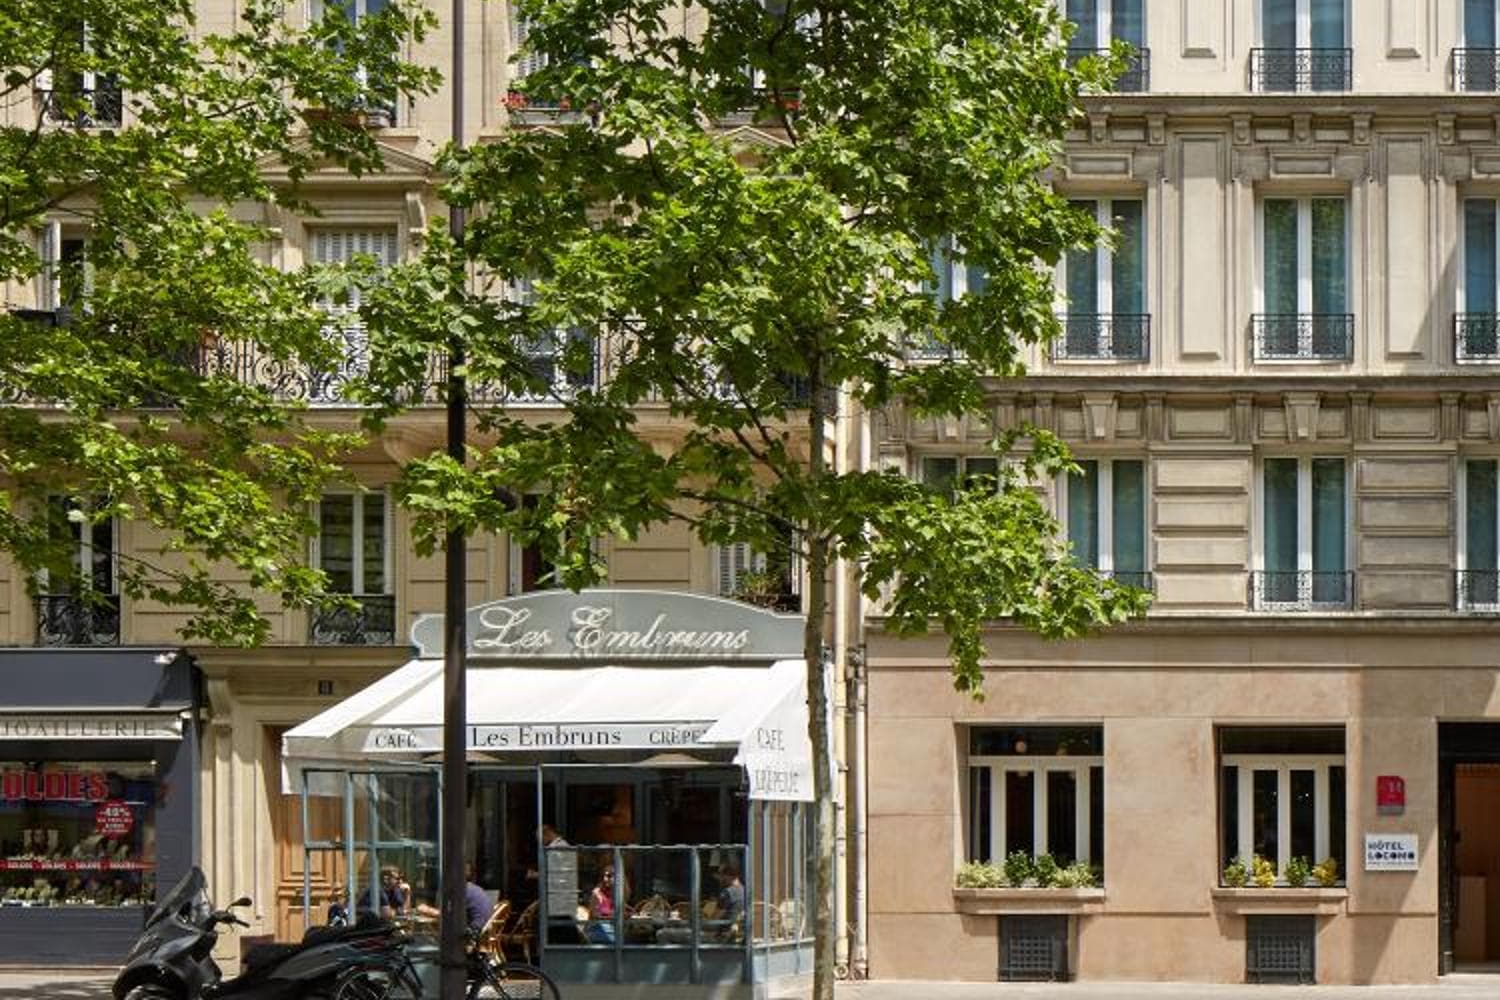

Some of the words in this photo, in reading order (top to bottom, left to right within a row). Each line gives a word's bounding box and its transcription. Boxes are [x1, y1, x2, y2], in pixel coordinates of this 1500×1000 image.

[473, 605, 551, 649] Les
[571, 606, 750, 653] Embruns
[473, 726, 509, 747] Les
[519, 725, 621, 746] Embruns
[649, 727, 708, 746] CRÊPE
